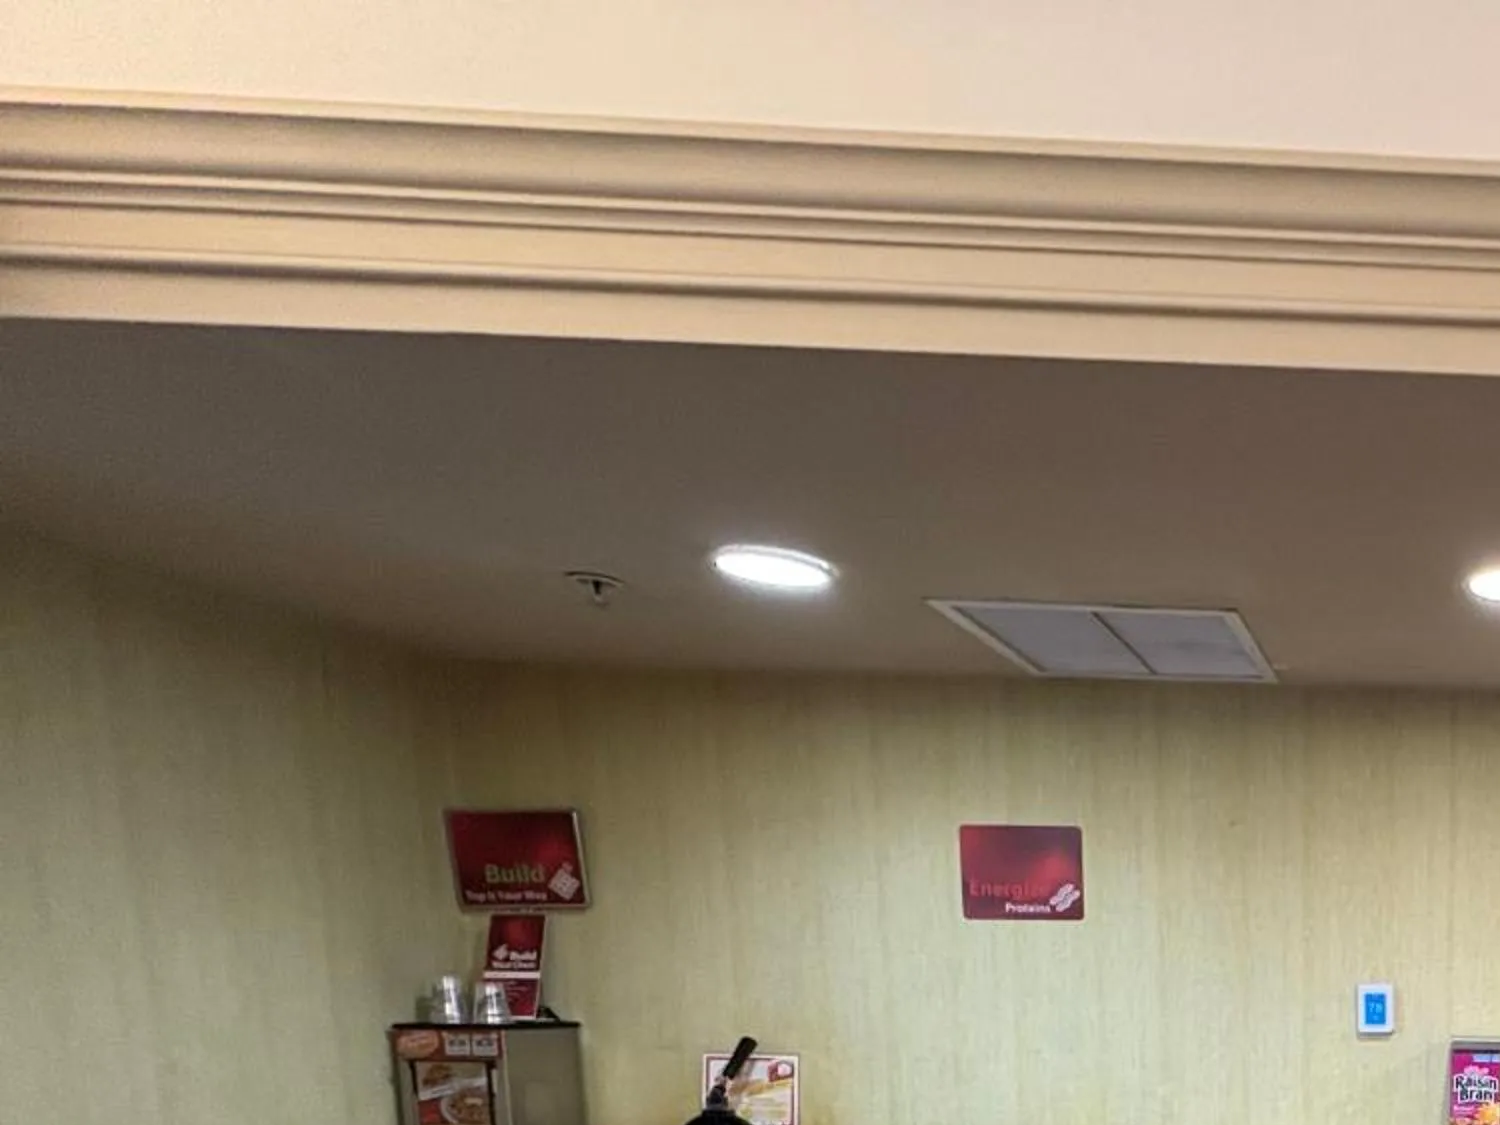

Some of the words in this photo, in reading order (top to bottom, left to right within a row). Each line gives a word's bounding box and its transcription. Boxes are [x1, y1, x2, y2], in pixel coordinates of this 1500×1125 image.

[485, 863, 546, 884] Build
[1455, 1075, 1498, 1091] Raisin
[1459, 1087, 1494, 1102] Bran
